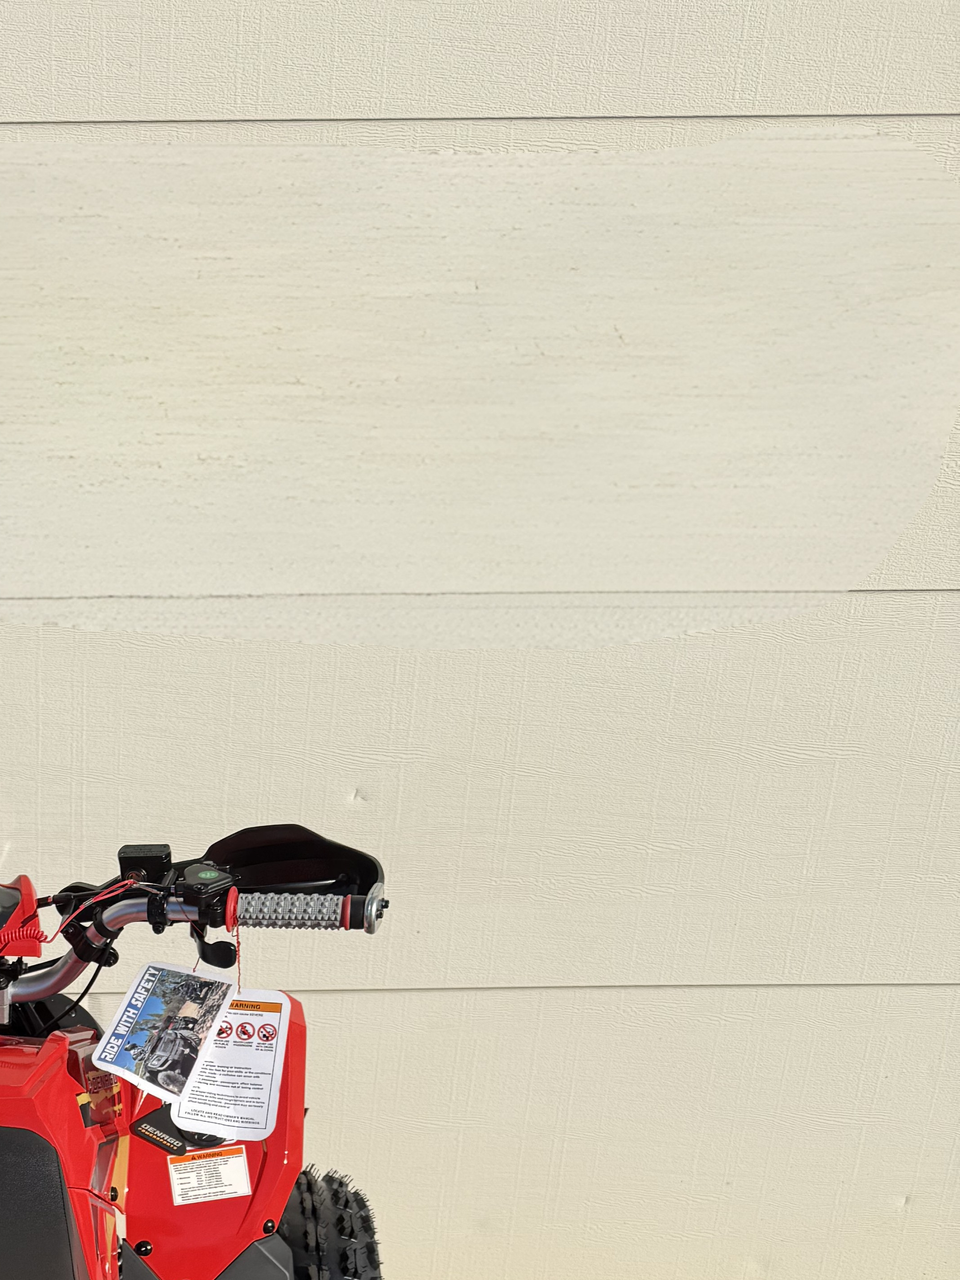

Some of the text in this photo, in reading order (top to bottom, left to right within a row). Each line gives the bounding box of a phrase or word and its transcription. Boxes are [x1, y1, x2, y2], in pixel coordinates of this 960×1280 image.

[100, 966, 160, 1062] RIDE WITH SAFETY
[138, 1127, 178, 1150] POWERSPORTS
[141, 1123, 182, 1148] DENAGO
